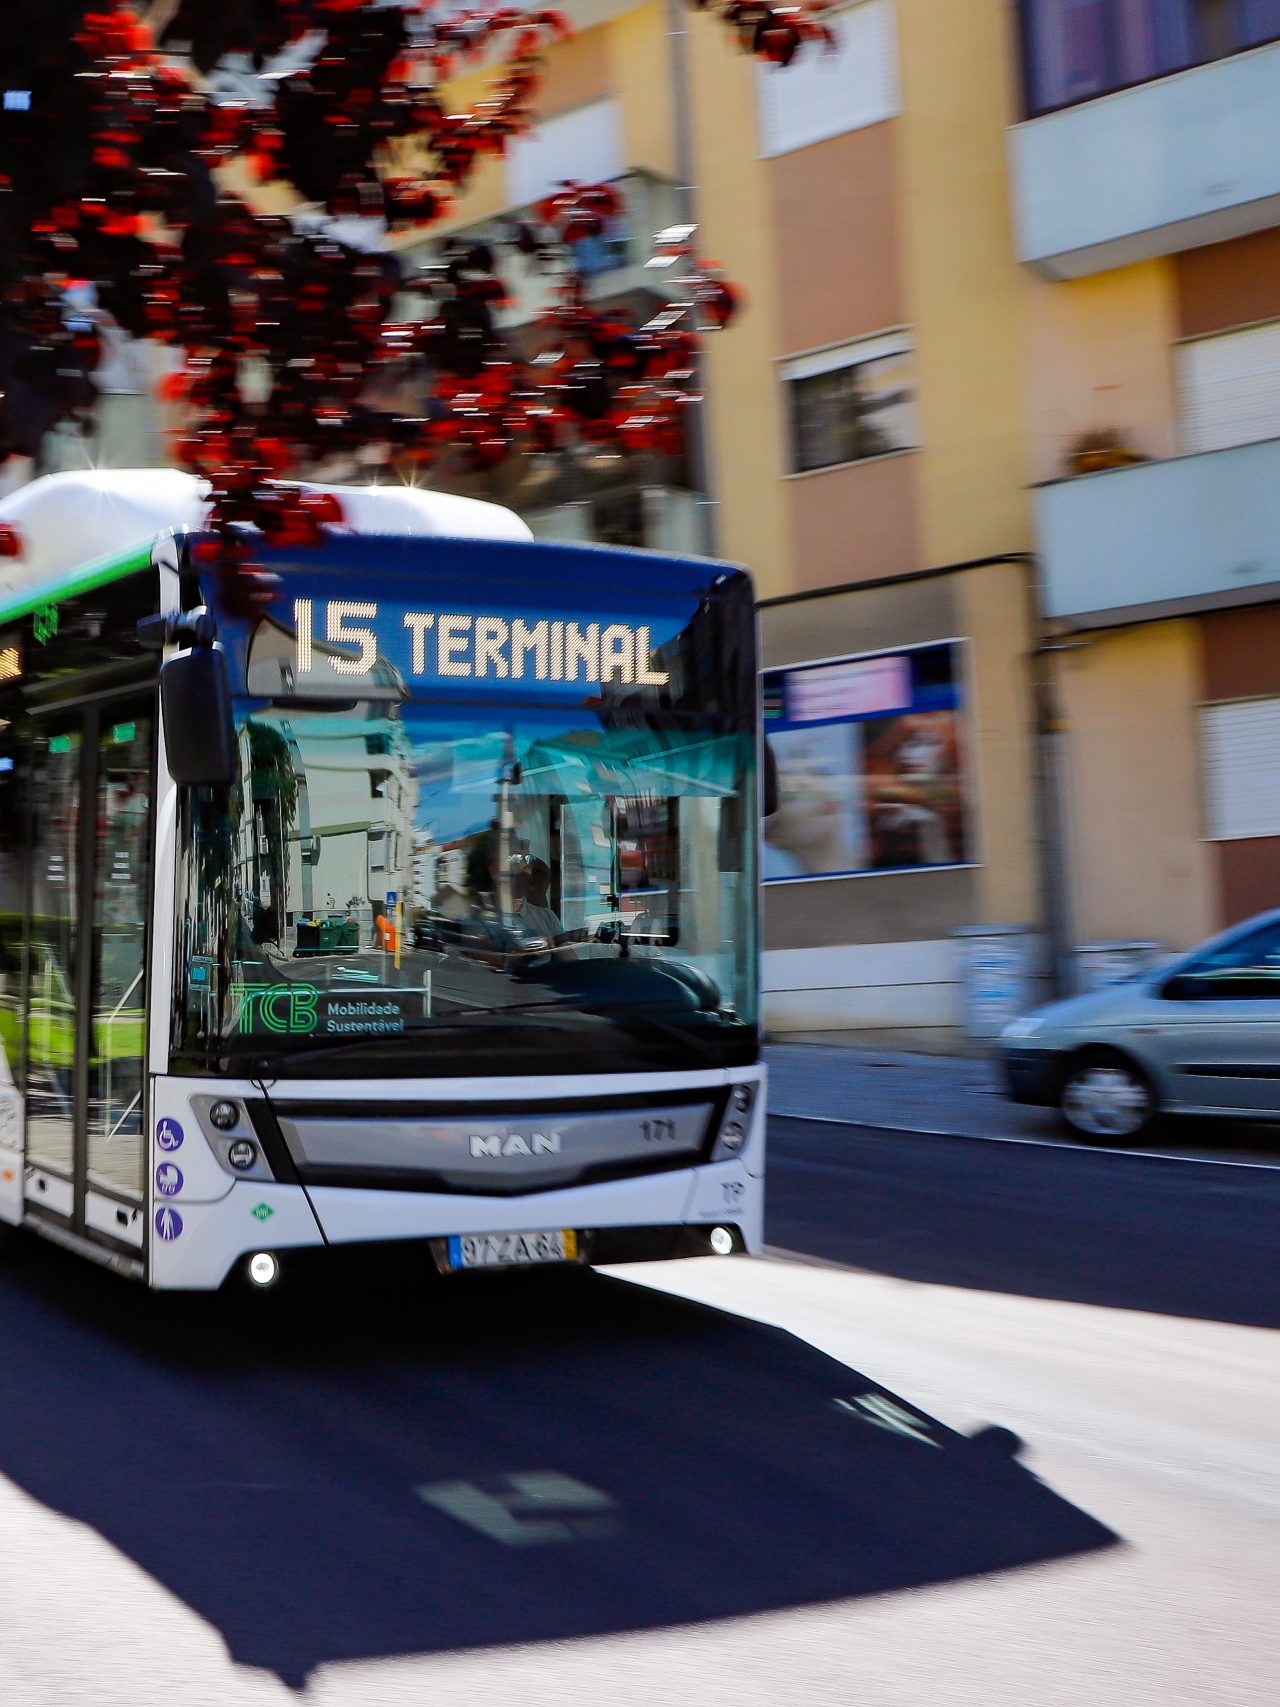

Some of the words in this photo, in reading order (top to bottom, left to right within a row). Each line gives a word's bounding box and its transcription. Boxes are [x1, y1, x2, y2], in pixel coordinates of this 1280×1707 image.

[294, 598, 377, 676] 15
[403, 612, 670, 685] TERMINAL
[230, 983, 318, 1033] TCB
[327, 1002, 400, 1016] Mobilidade
[327, 1018, 404, 1033] Sustentável
[639, 1119, 676, 1141] 171
[469, 1132, 562, 1158] MAN
